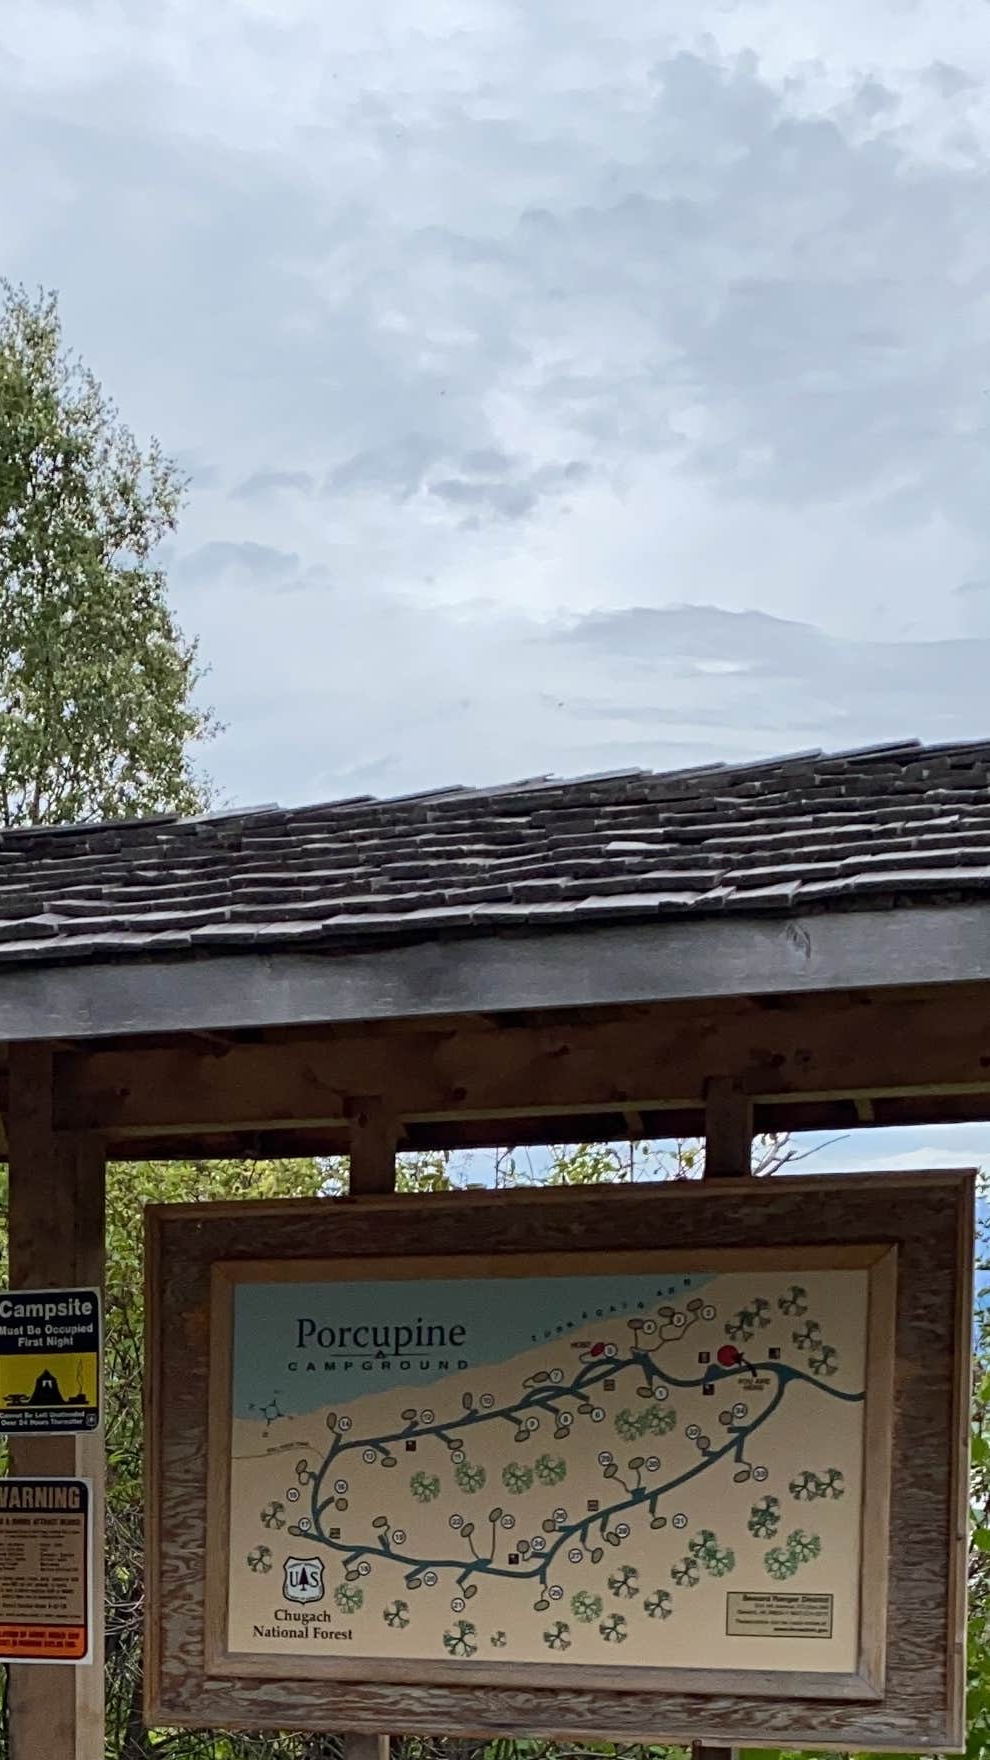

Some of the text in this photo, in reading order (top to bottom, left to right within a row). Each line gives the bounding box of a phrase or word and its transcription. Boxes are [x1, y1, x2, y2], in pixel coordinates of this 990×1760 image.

[27, 1325, 41, 1335] Be
[44, 1323, 94, 1336] Occupied
[18, 1336, 74, 1348] First Night
[296, 1317, 466, 1356] Porcupine
[288, 1360, 469, 1372] CAMPGROUND
[274, 1609, 331, 1626] Chugach
[253, 1626, 353, 1640] National Forest
